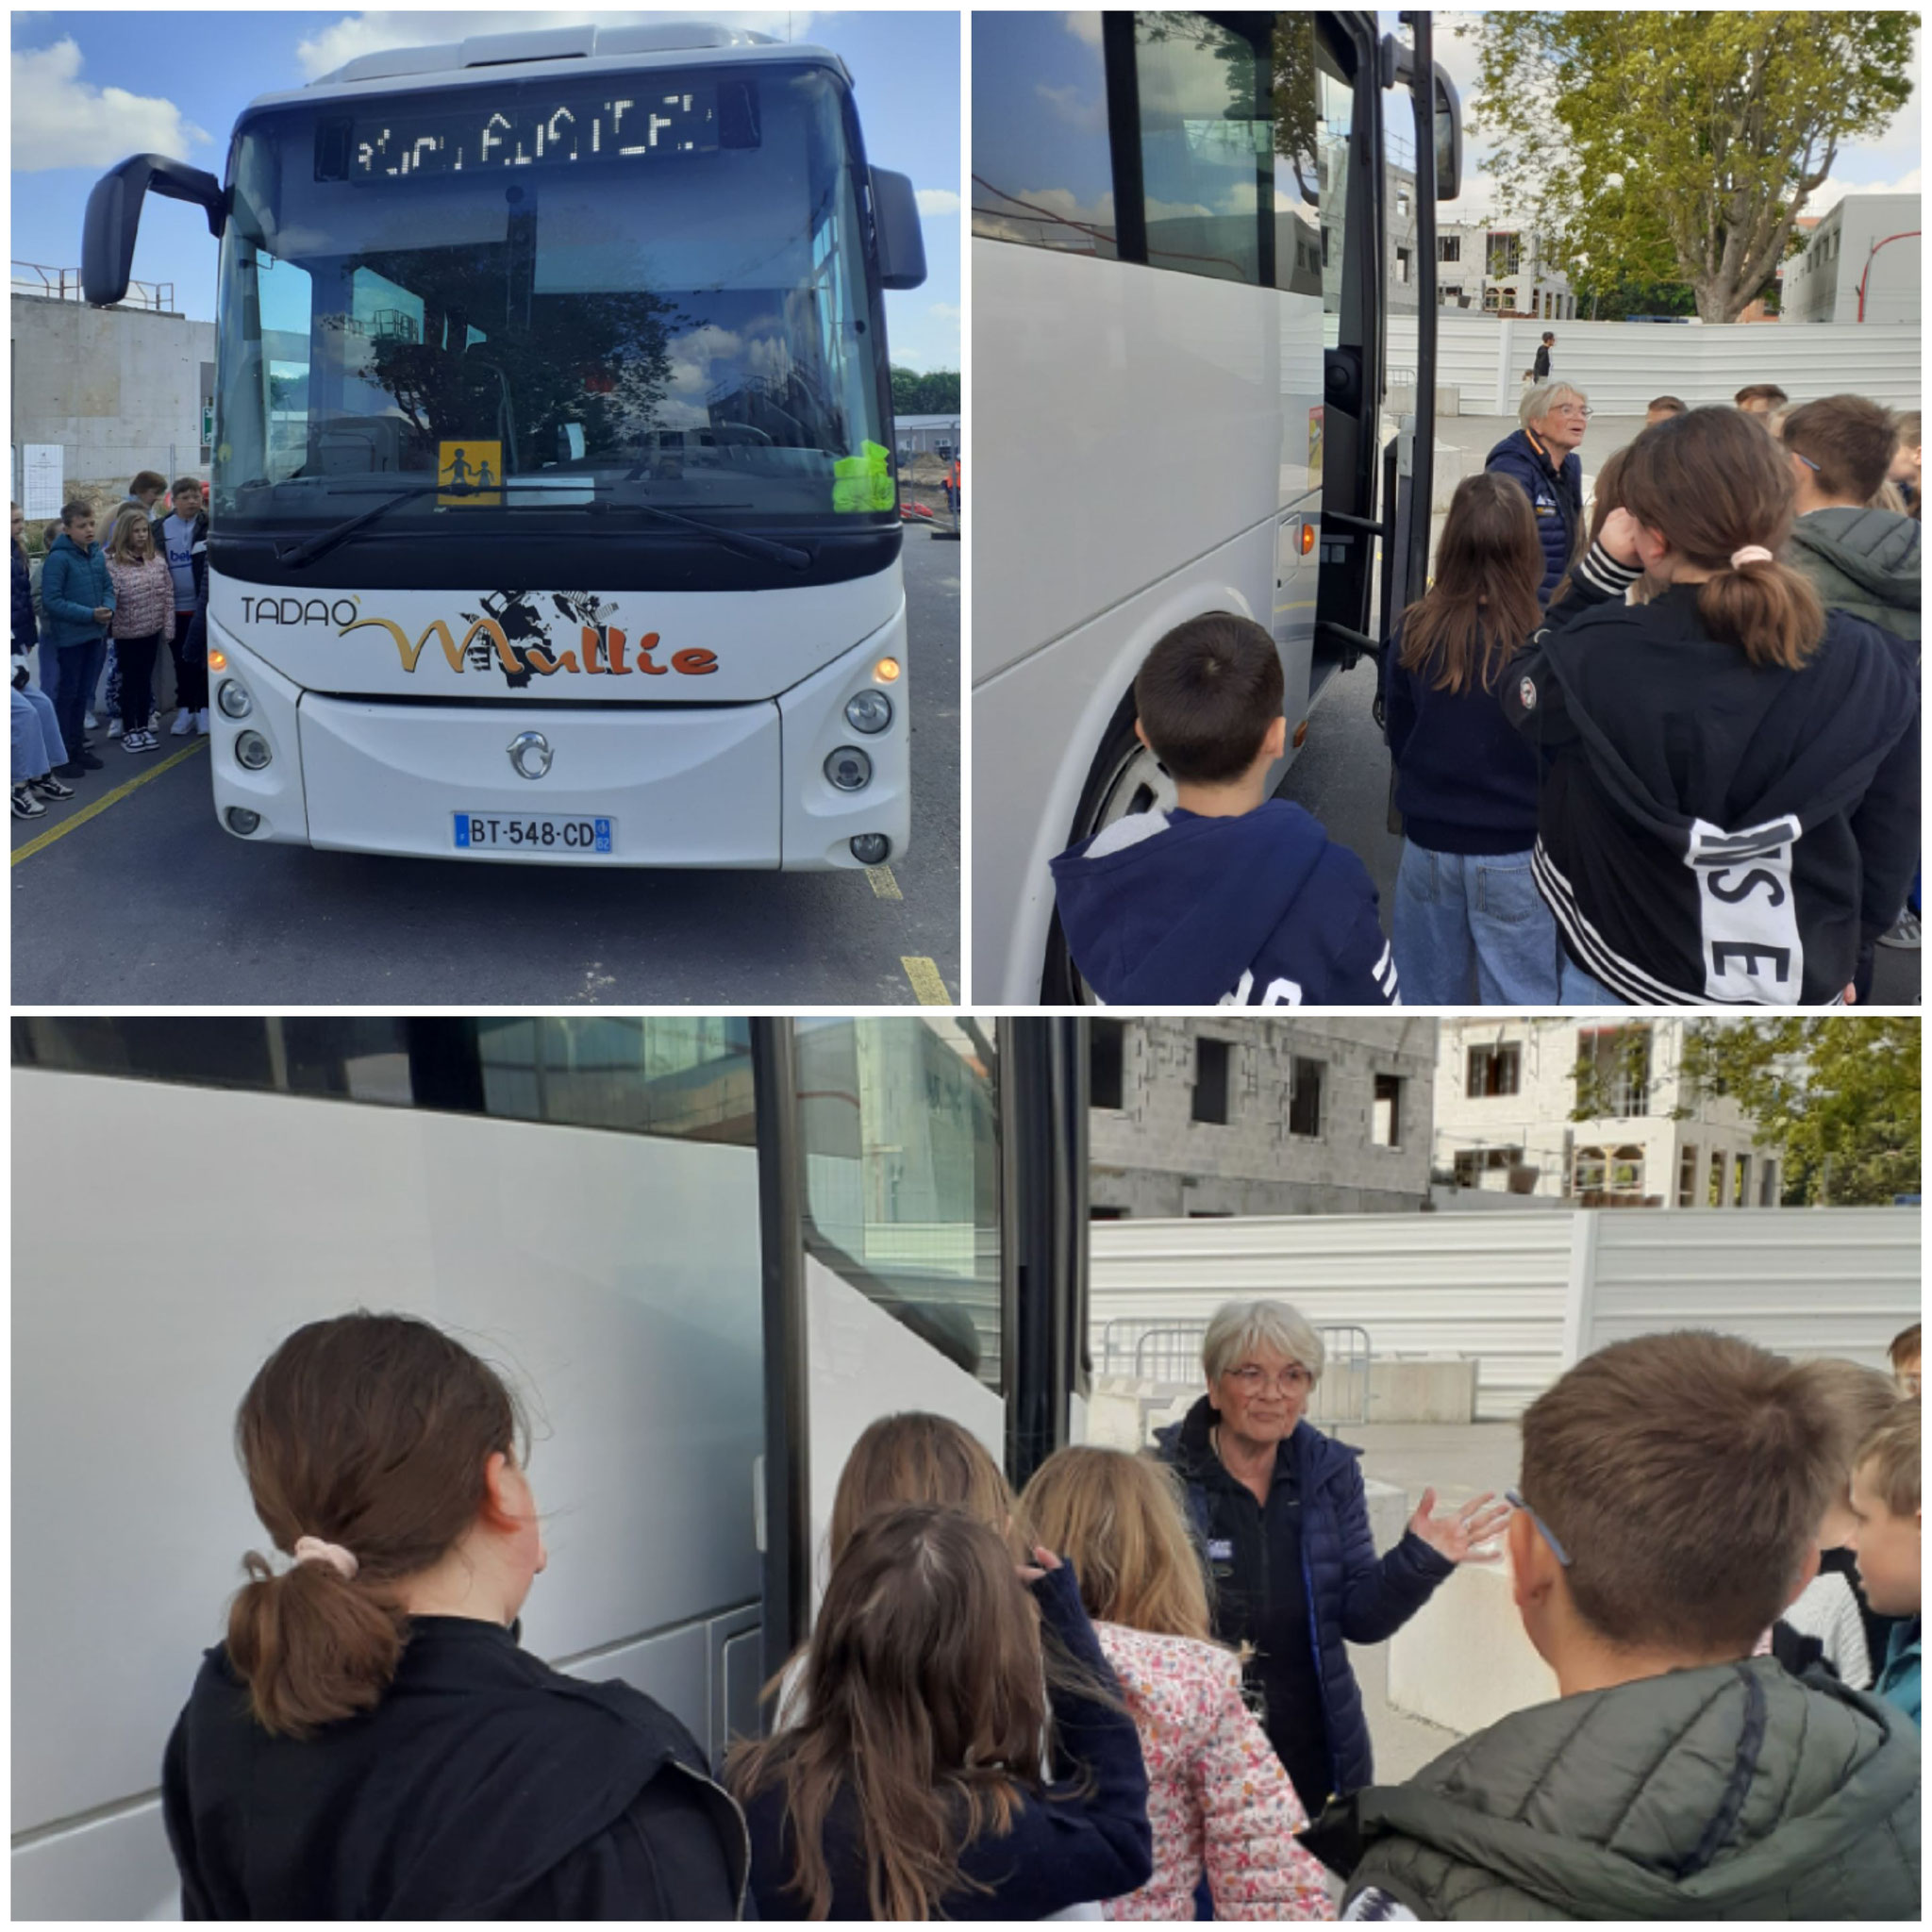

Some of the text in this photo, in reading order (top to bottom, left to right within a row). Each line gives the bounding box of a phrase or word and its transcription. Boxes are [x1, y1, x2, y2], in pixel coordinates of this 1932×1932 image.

[338, 617, 719, 675] Mullie
[471, 819, 595, 847] BT-548-CD
[596, 838, 610, 850] 62
